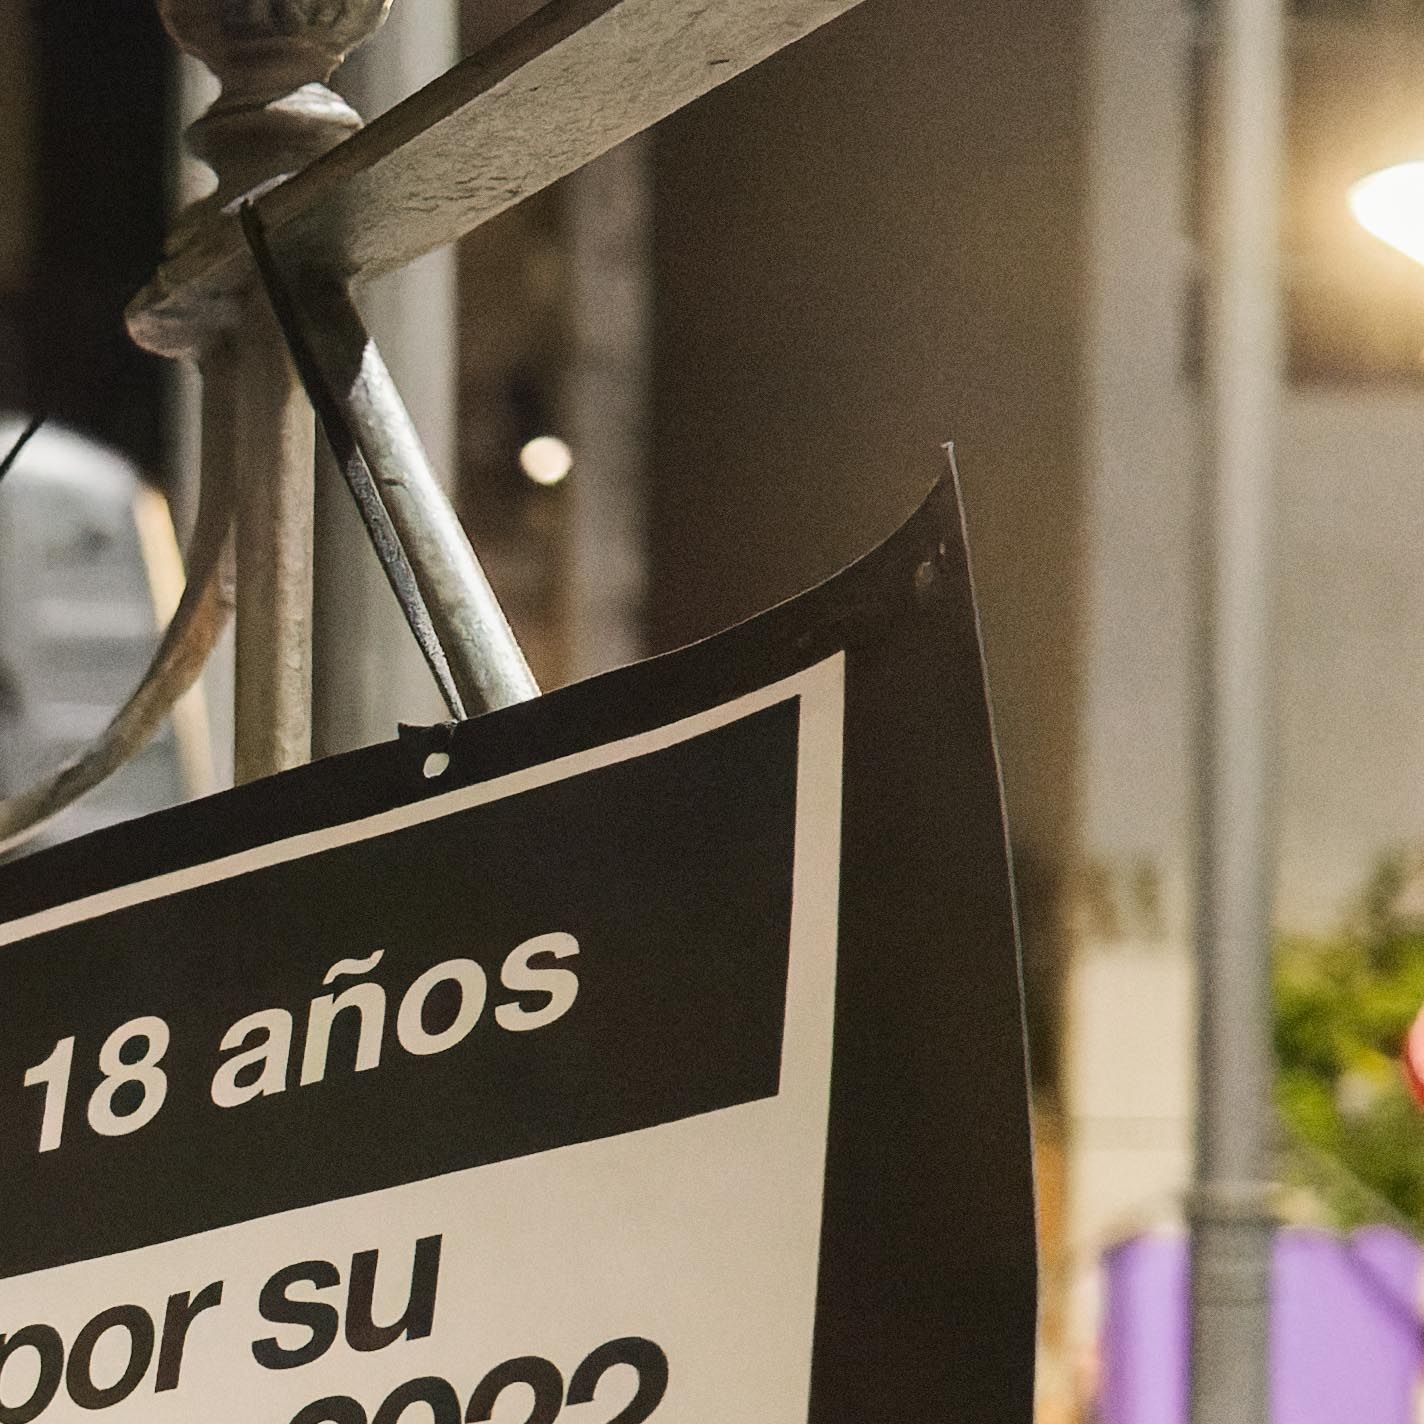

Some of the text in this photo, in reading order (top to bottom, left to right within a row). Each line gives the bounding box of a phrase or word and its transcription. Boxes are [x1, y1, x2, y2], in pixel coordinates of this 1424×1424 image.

[22, 1014, 171, 1155] 18
[209, 930, 582, 1109] años
[250, 1232, 444, 1371] su
